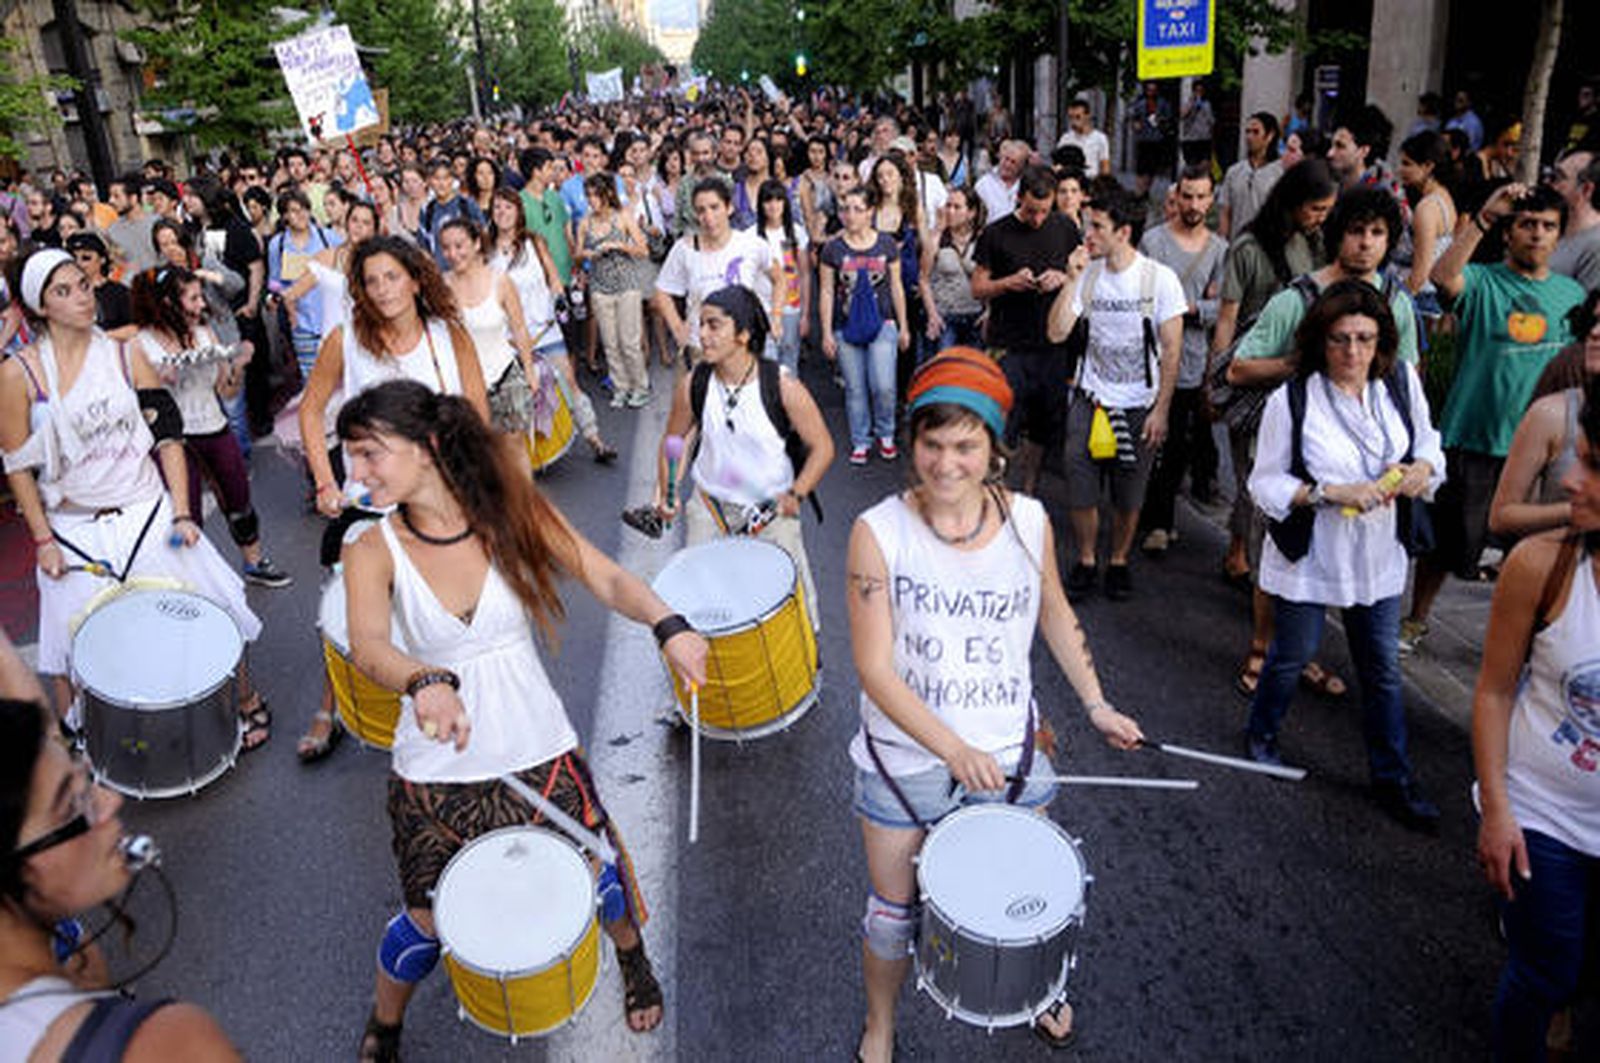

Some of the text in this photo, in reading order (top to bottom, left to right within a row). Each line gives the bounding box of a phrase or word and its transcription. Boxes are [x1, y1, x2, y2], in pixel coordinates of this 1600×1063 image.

[1159, 22, 1196, 39] TAXI
[904, 633, 1003, 664] NO ES
